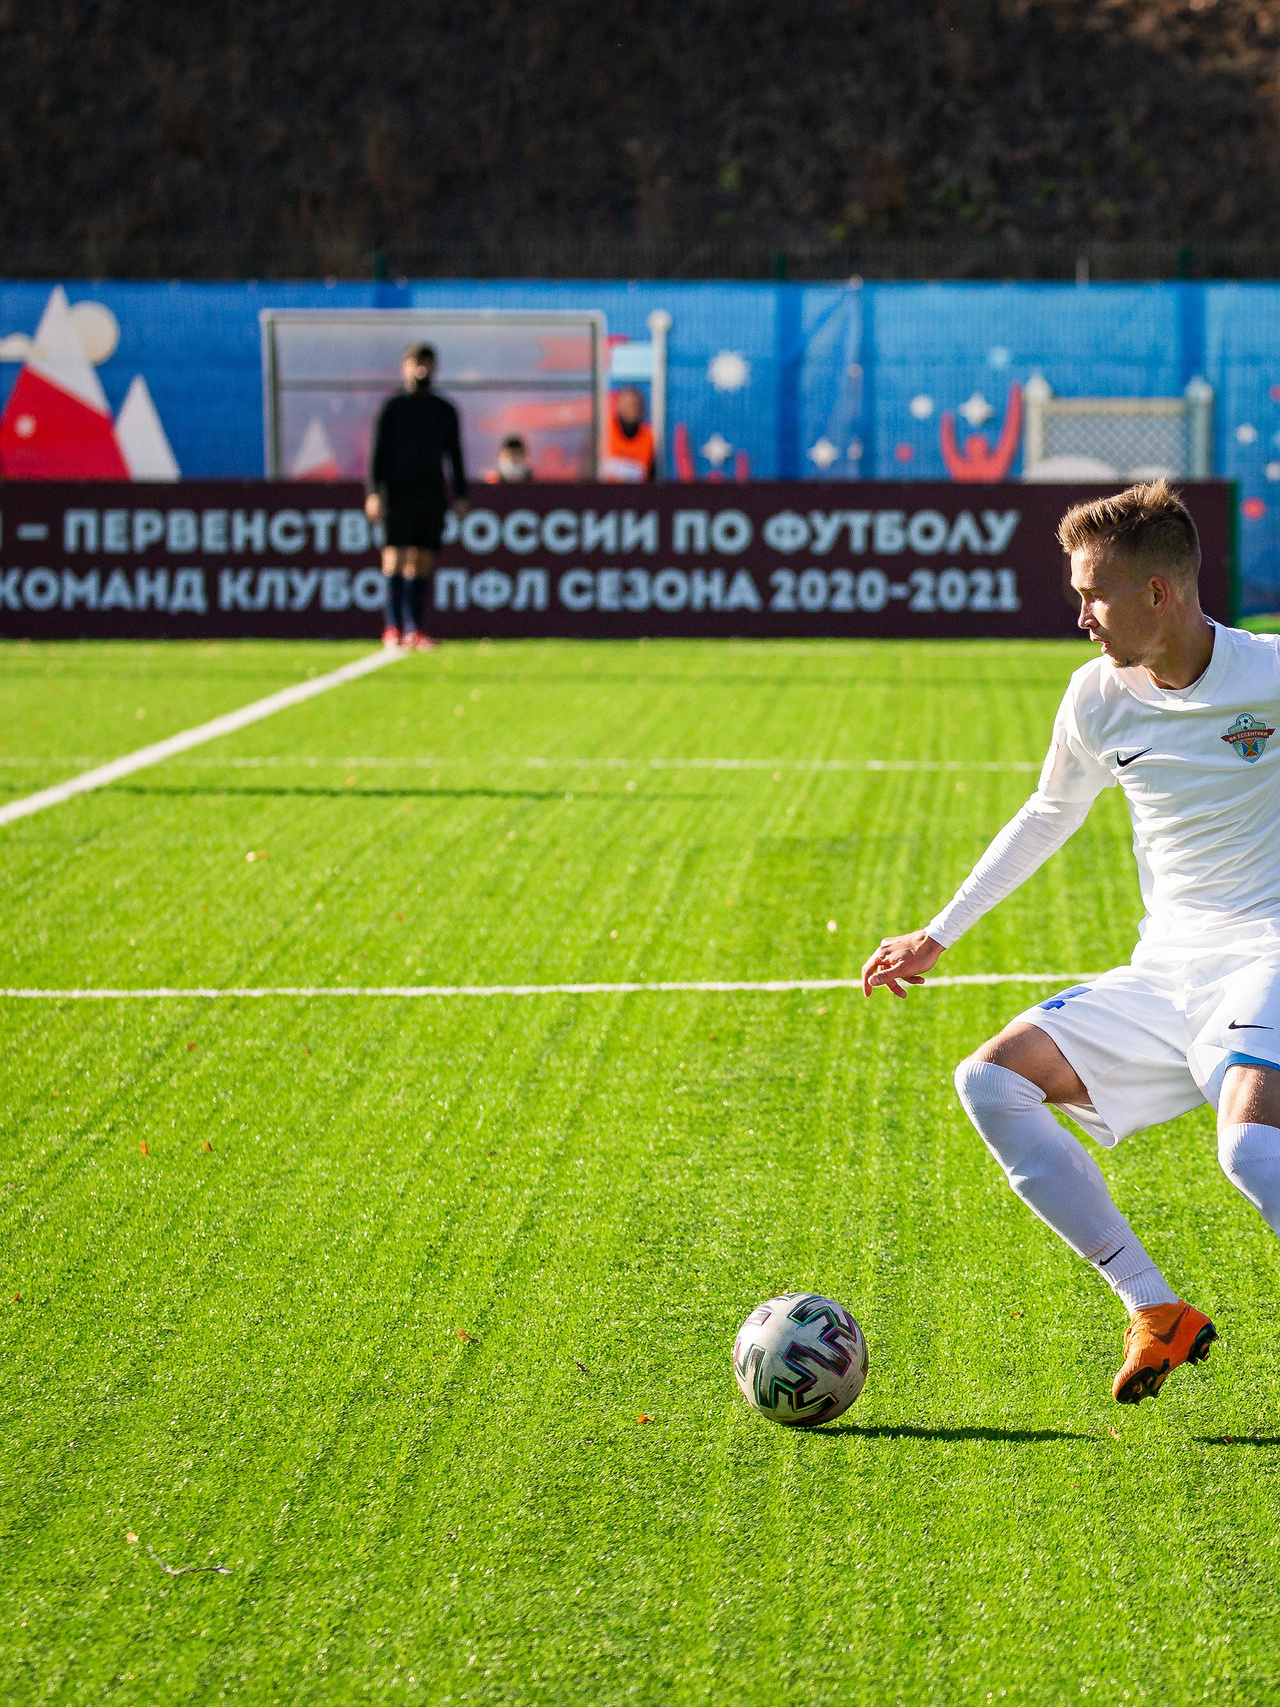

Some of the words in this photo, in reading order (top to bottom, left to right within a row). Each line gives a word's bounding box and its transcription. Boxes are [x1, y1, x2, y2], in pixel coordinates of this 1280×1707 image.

[63, 508, 387, 553] ПЕРВЕНСТВ
[672, 508, 753, 554] ПО
[762, 508, 1019, 555] ФУТБОЛУ
[0, 567, 208, 613] КОМАНД
[218, 567, 392, 611] КЛУБО
[433, 568, 549, 611] ПФЛ
[558, 567, 762, 612] СЕЗОНА
[769, 567, 1021, 612] 2020-2021
